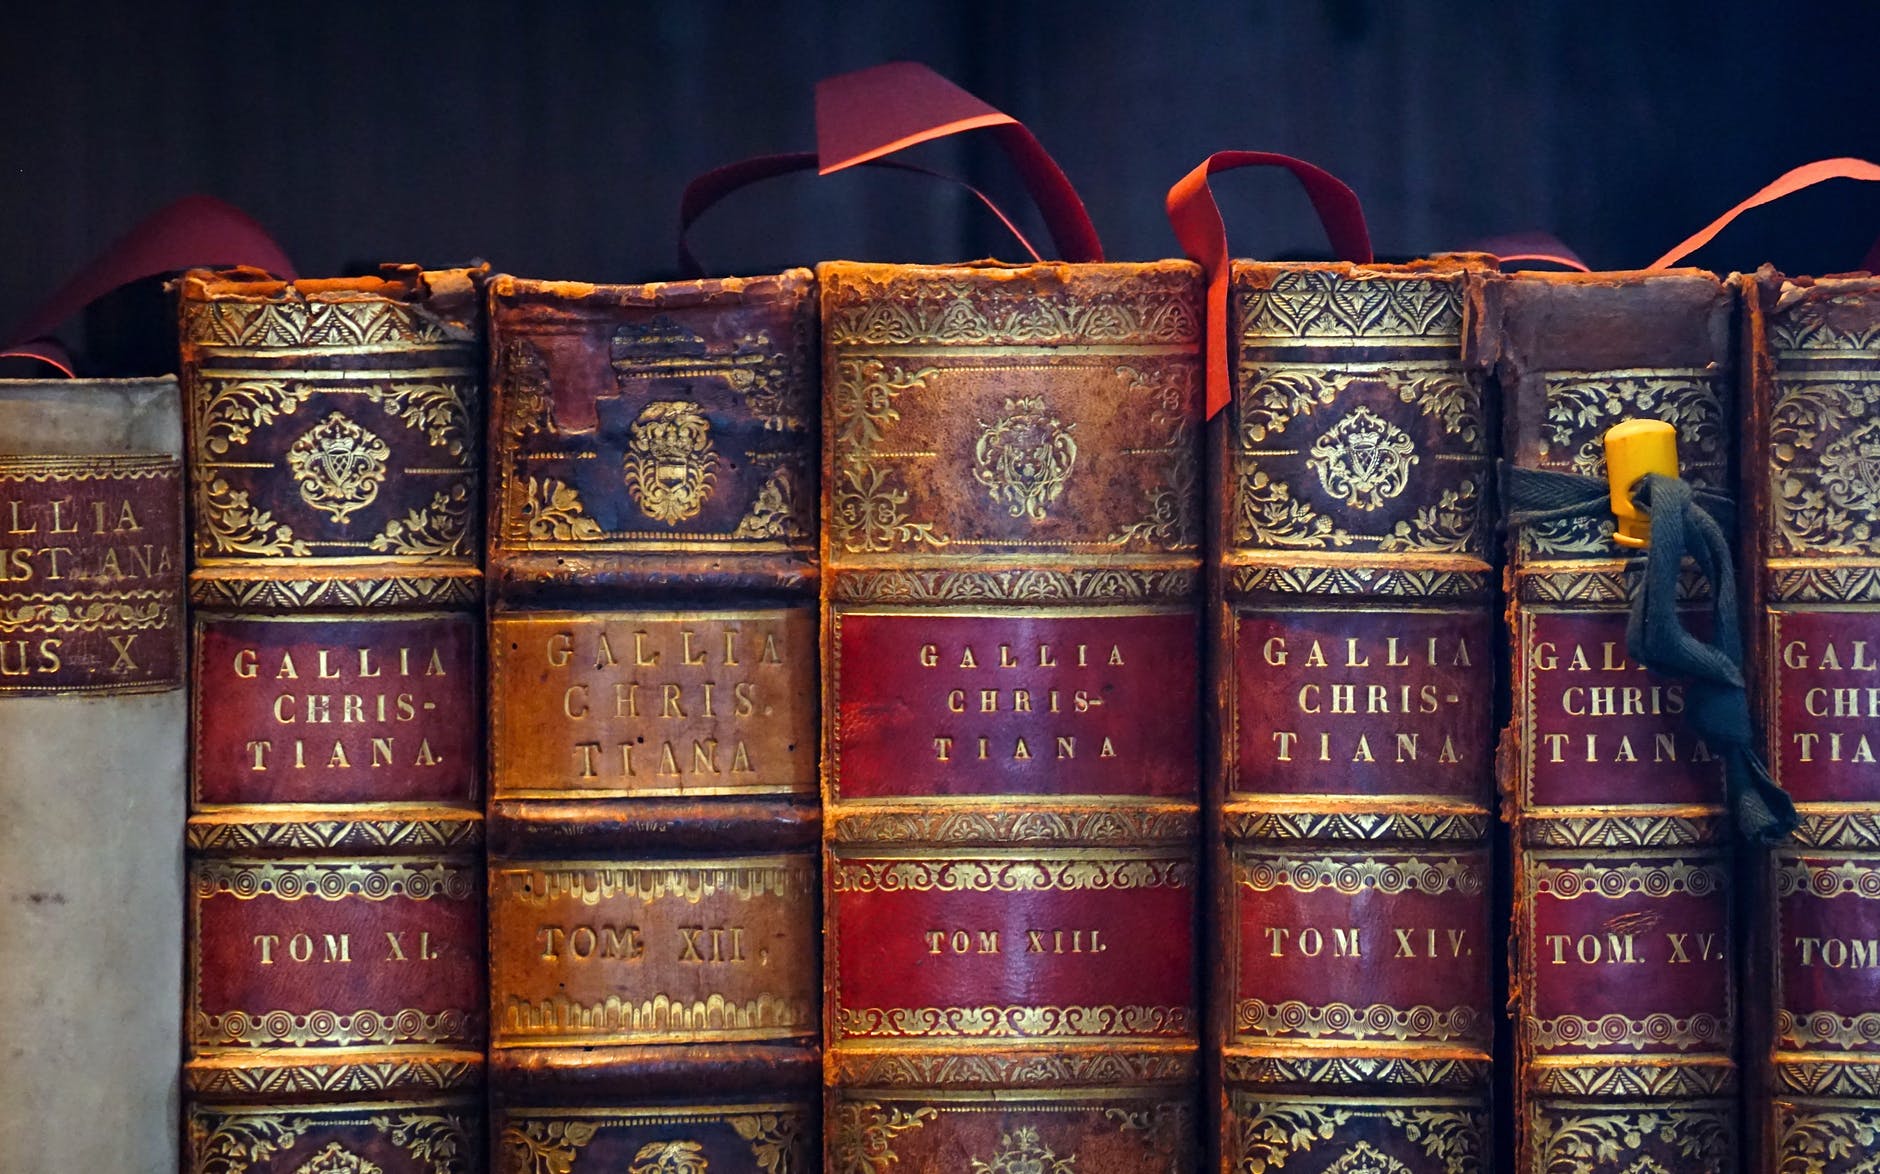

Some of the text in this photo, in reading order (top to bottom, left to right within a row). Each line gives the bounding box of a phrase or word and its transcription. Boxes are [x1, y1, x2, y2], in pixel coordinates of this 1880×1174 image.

[0, 544, 171, 582] ISTANA
[234, 648, 445, 679] GALLIA
[547, 631, 783, 667] GALLIA
[920, 644, 1124, 668] GALLIA
[1263, 637, 1472, 667] GALLIA
[274, 694, 436, 724] CHRIS-
[948, 690, 1103, 713] CHRIS-
[1299, 684, 1459, 714] CHRIS-
[247, 738, 443, 771] TIANA.
[575, 738, 755, 777] TIANA
[934, 737, 1116, 760] TIANA
[1793, 733, 1877, 762] TIA
[254, 932, 438, 964] TOM XI.
[926, 930, 1106, 954] TOM XIII.
[1265, 928, 1472, 957] TOM XIV.
[1546, 933, 1724, 964] TOM. XV.
